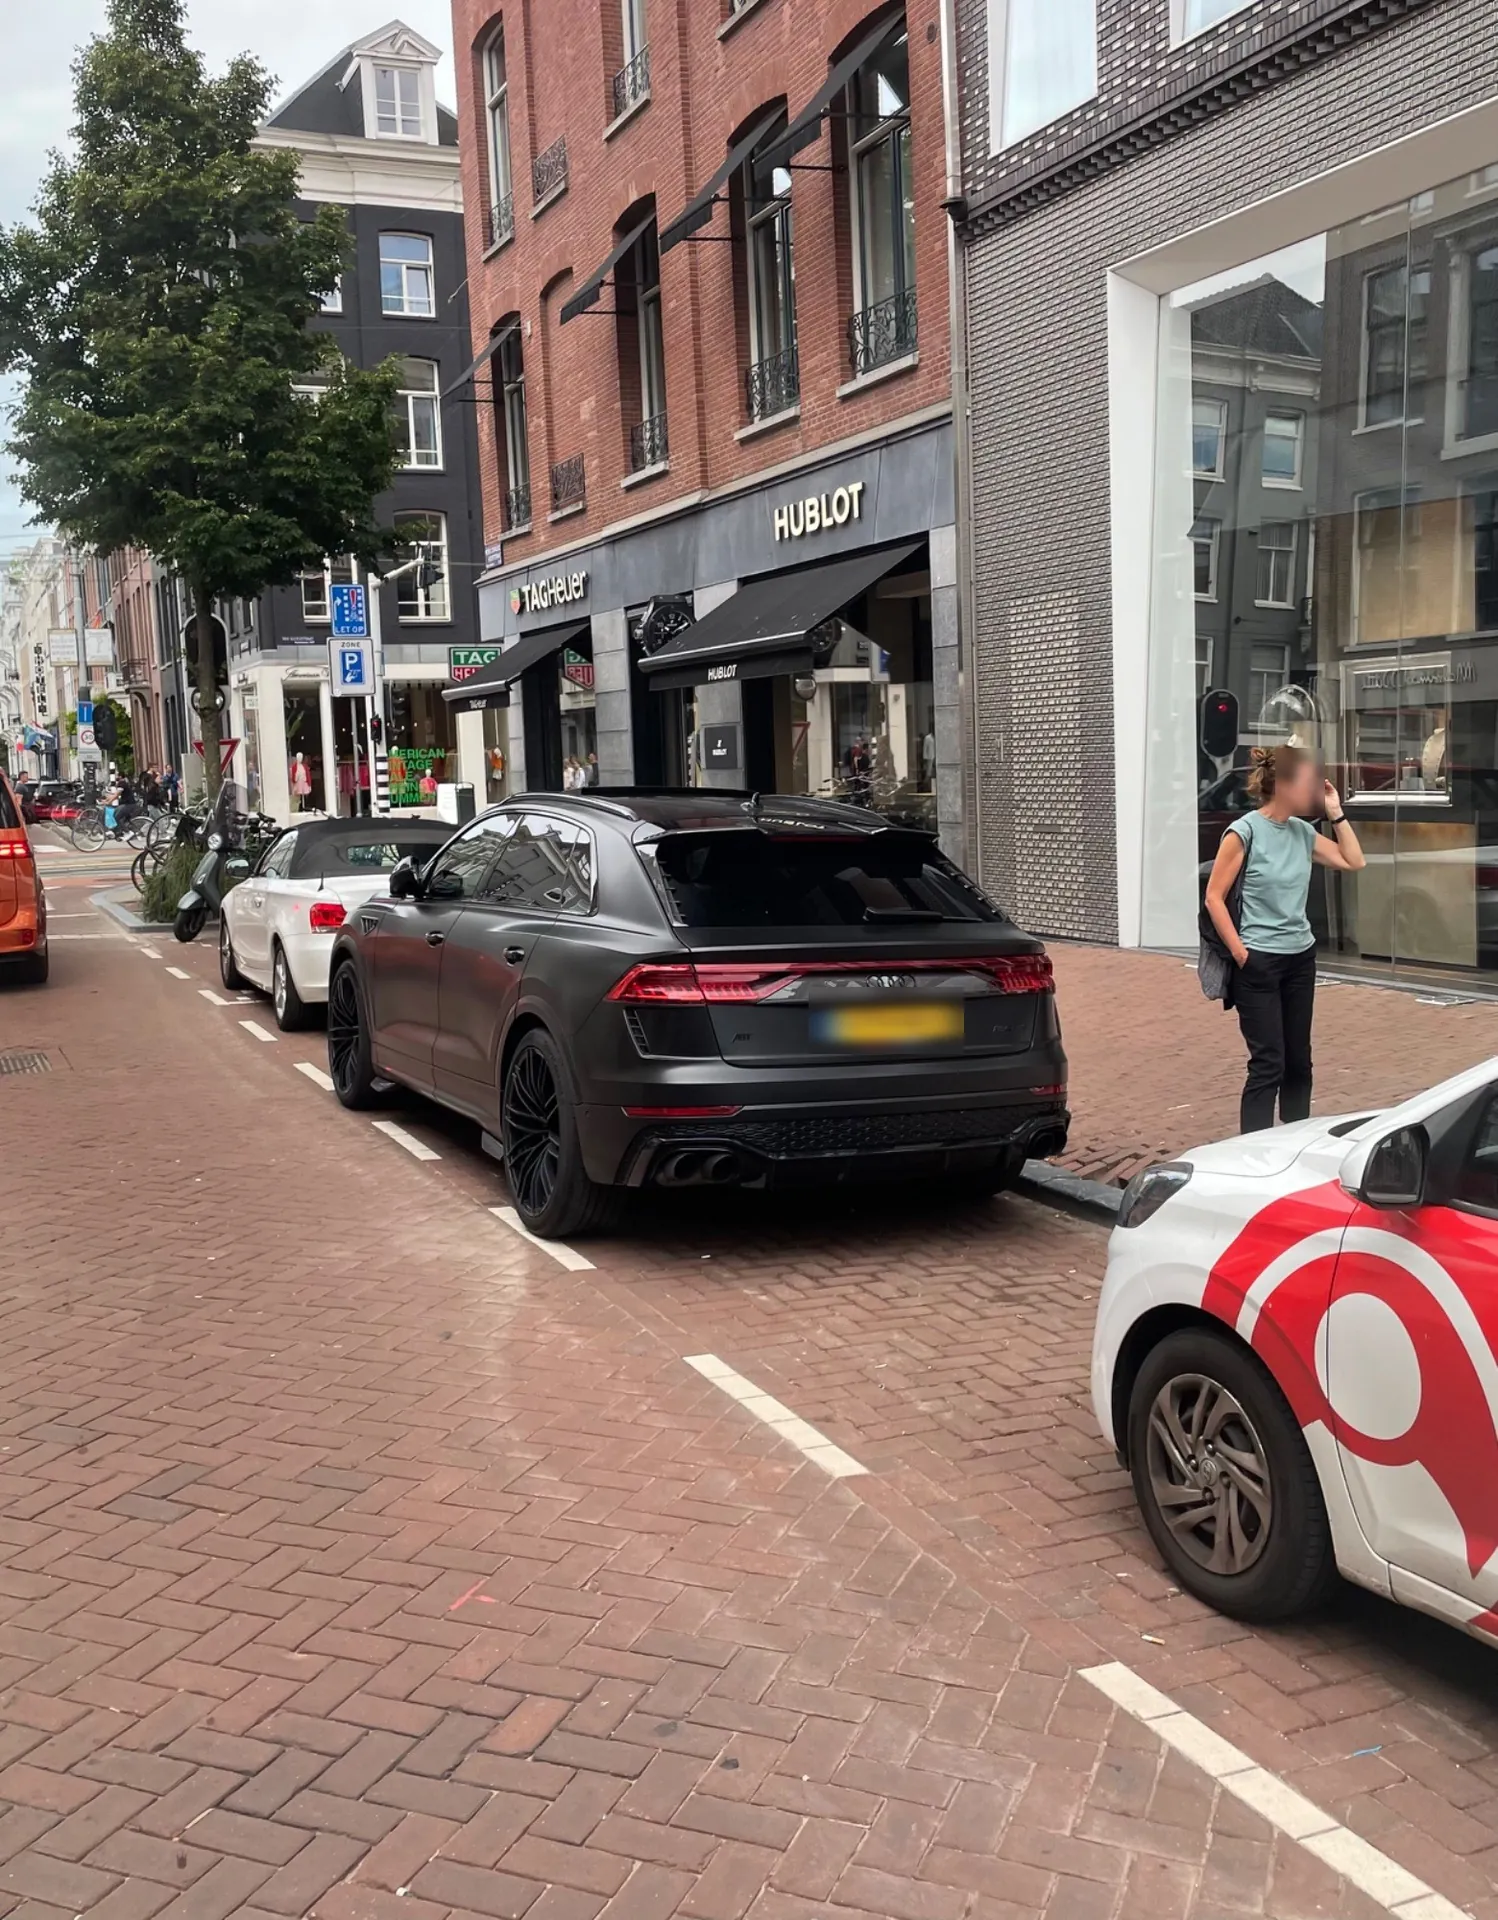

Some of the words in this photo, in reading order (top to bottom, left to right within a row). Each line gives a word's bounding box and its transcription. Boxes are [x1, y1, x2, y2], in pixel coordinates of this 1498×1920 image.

[774, 482, 864, 541] HUBLOT
[345, 653, 358, 670] P
[708, 664, 738, 681] HUBLOT
